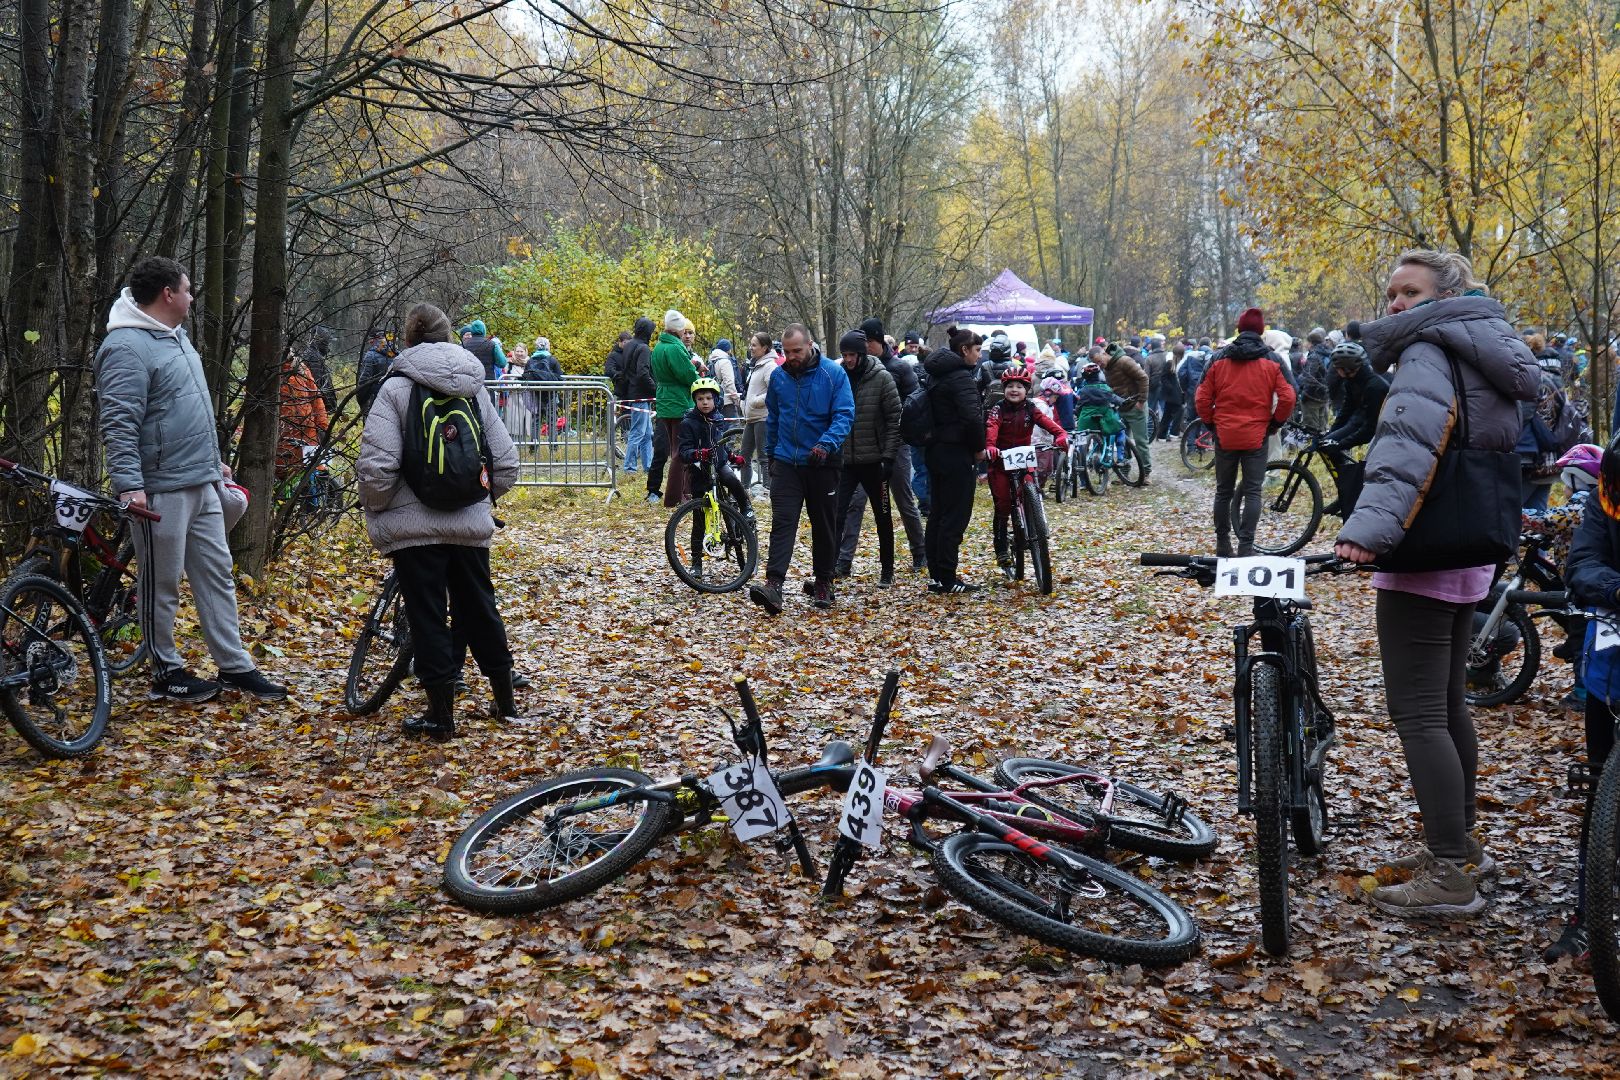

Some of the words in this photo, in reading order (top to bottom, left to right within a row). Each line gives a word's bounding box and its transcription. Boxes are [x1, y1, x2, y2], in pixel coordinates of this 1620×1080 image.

[1006, 451, 1035, 465] 124
[1222, 566, 1295, 589] 101
[167, 685, 188, 694] HOKA
[725, 767, 778, 828] 387
[847, 767, 876, 840] 439
